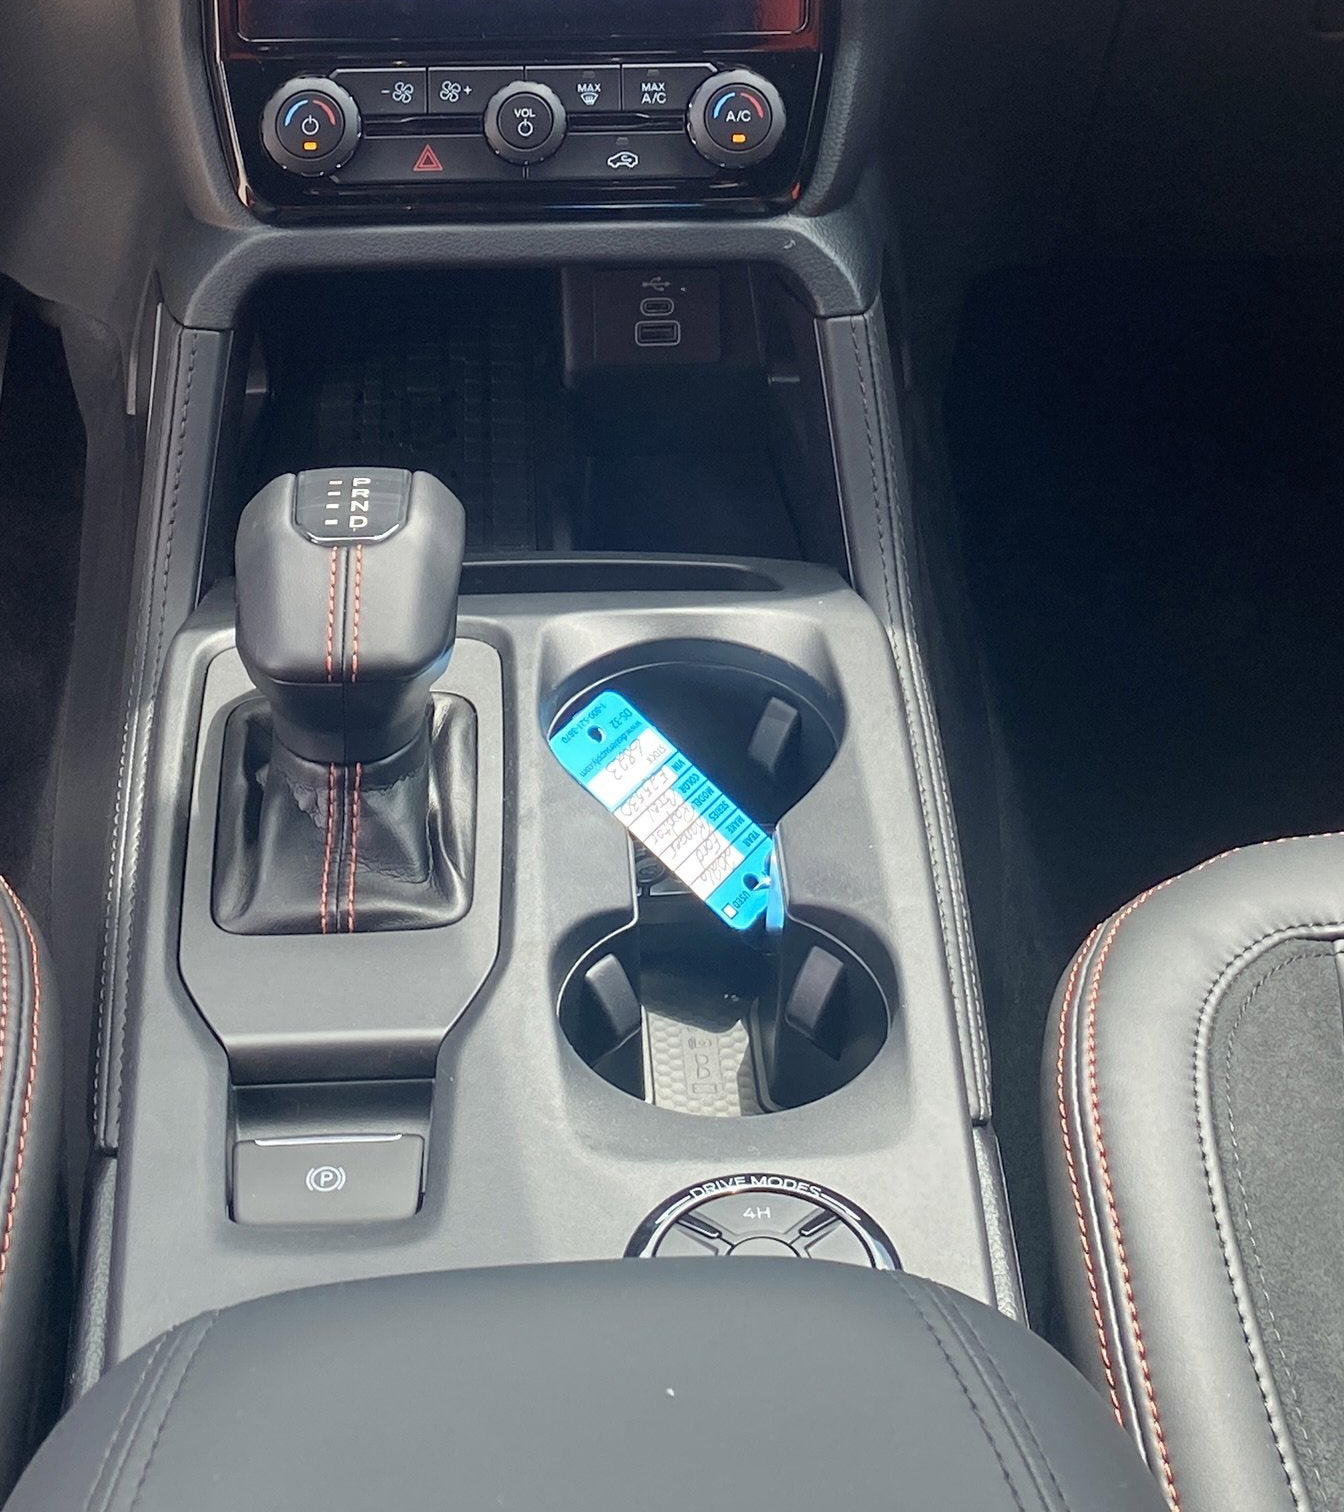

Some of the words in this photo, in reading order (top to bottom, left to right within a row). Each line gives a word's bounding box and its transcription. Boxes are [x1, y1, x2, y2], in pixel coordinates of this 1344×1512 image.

[577, 84, 601, 92] MAX
[641, 83, 665, 91] MAX
[641, 93, 666, 104] A/C
[514, 108, 536, 118] VOL
[726, 111, 751, 122] A/C
[353, 477, 371, 487] P
[351, 488, 369, 498] R
[350, 500, 369, 512] N
[349, 515, 368, 529] D
[609, 707, 633, 729] DS-32
[646, 745, 666, 764] STOCK
[671, 758, 685, 772] VIN
[678, 773, 700, 794] COLOR
[691, 786, 714, 809] MODEL
[707, 801, 729, 821] SERIES
[725, 815, 745, 834] MAKE
[742, 830, 760, 847] YEAR
[732, 891, 751, 910] USED
[690, 1176, 746, 1199] DRIVE
[750, 1176, 823, 1198] MODES
[743, 1207, 771, 1219] 4H
